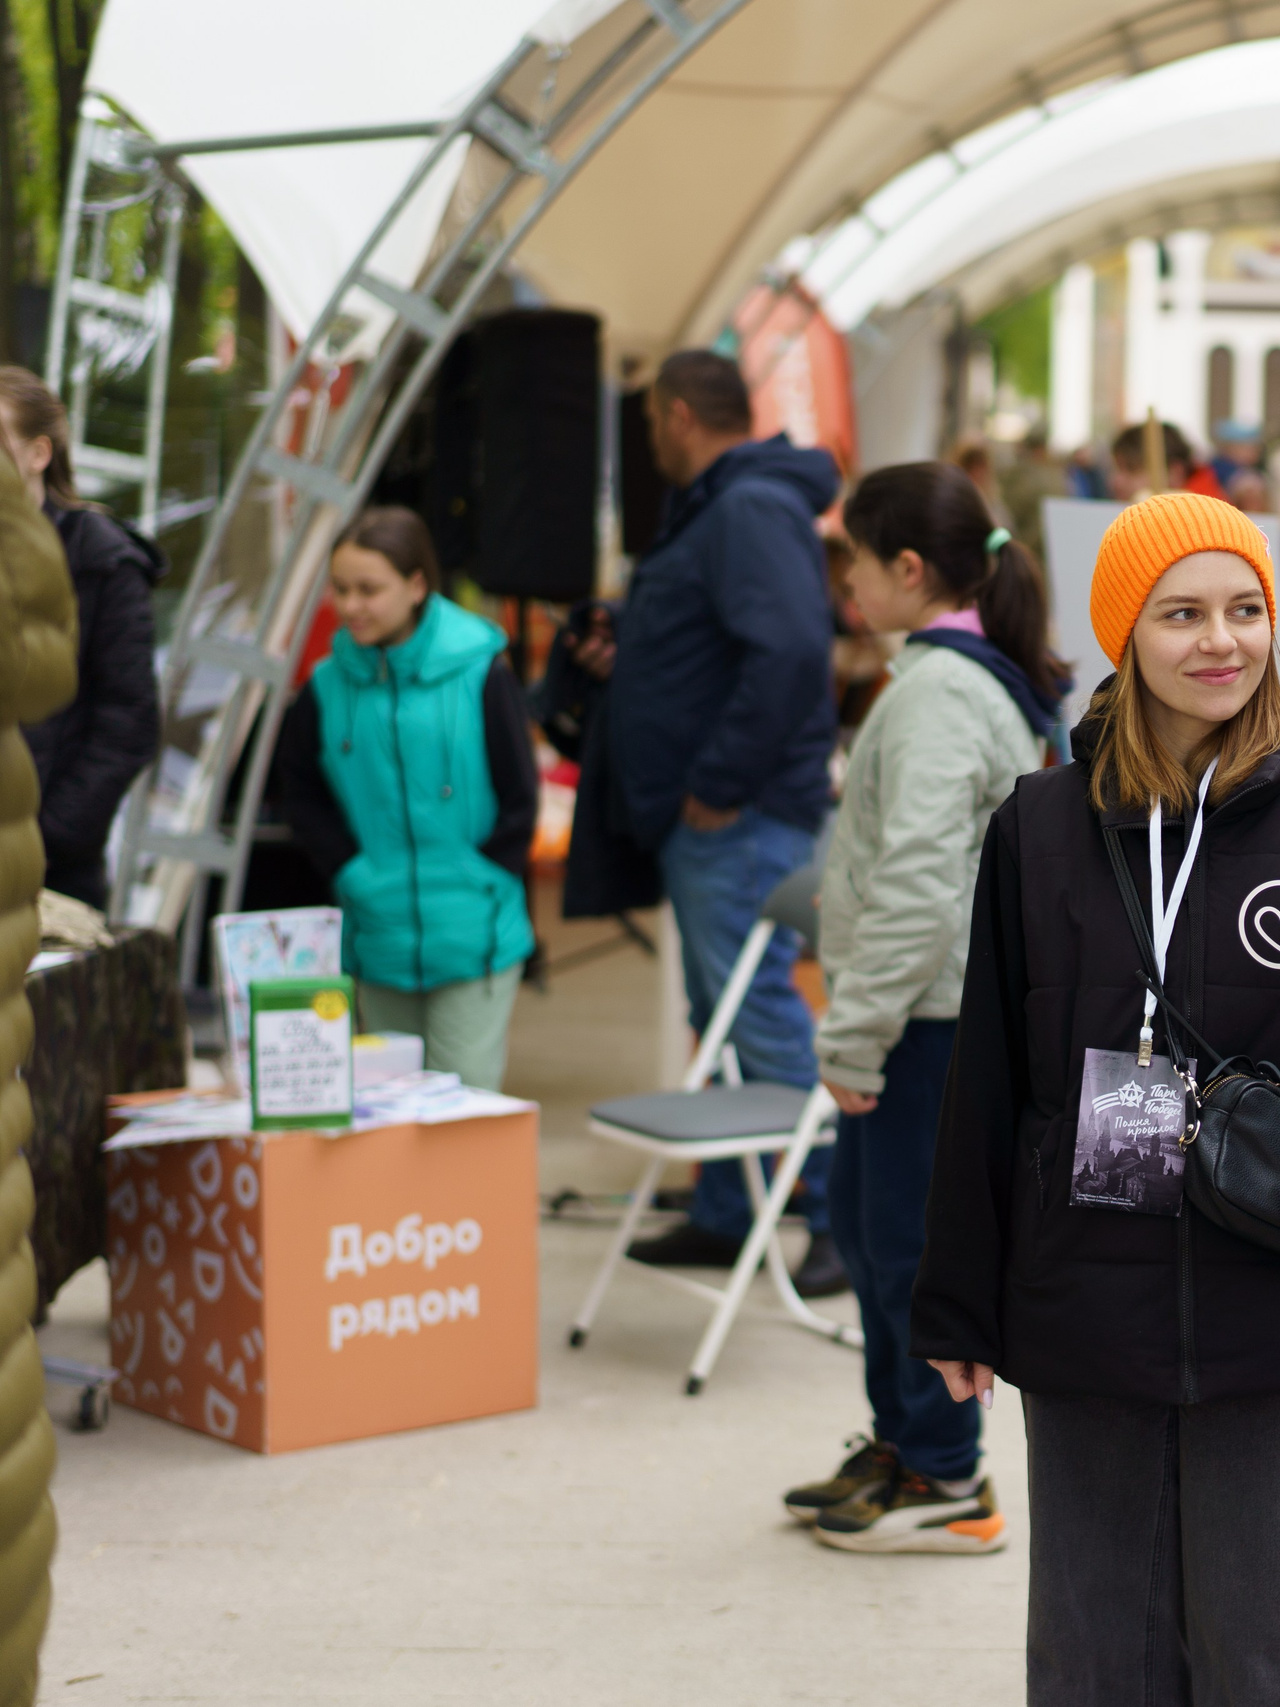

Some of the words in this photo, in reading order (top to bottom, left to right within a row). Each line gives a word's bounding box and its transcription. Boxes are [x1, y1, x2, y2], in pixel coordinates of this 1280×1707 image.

[1150, 1084, 1181, 1104] Парк
[1144, 1098, 1183, 1120] Победы
[1114, 1116, 1151, 1129] Помня
[1126, 1118, 1180, 1142] прошлое!
[325, 1213, 483, 1282] Добро
[329, 1284, 480, 1352] рядом
